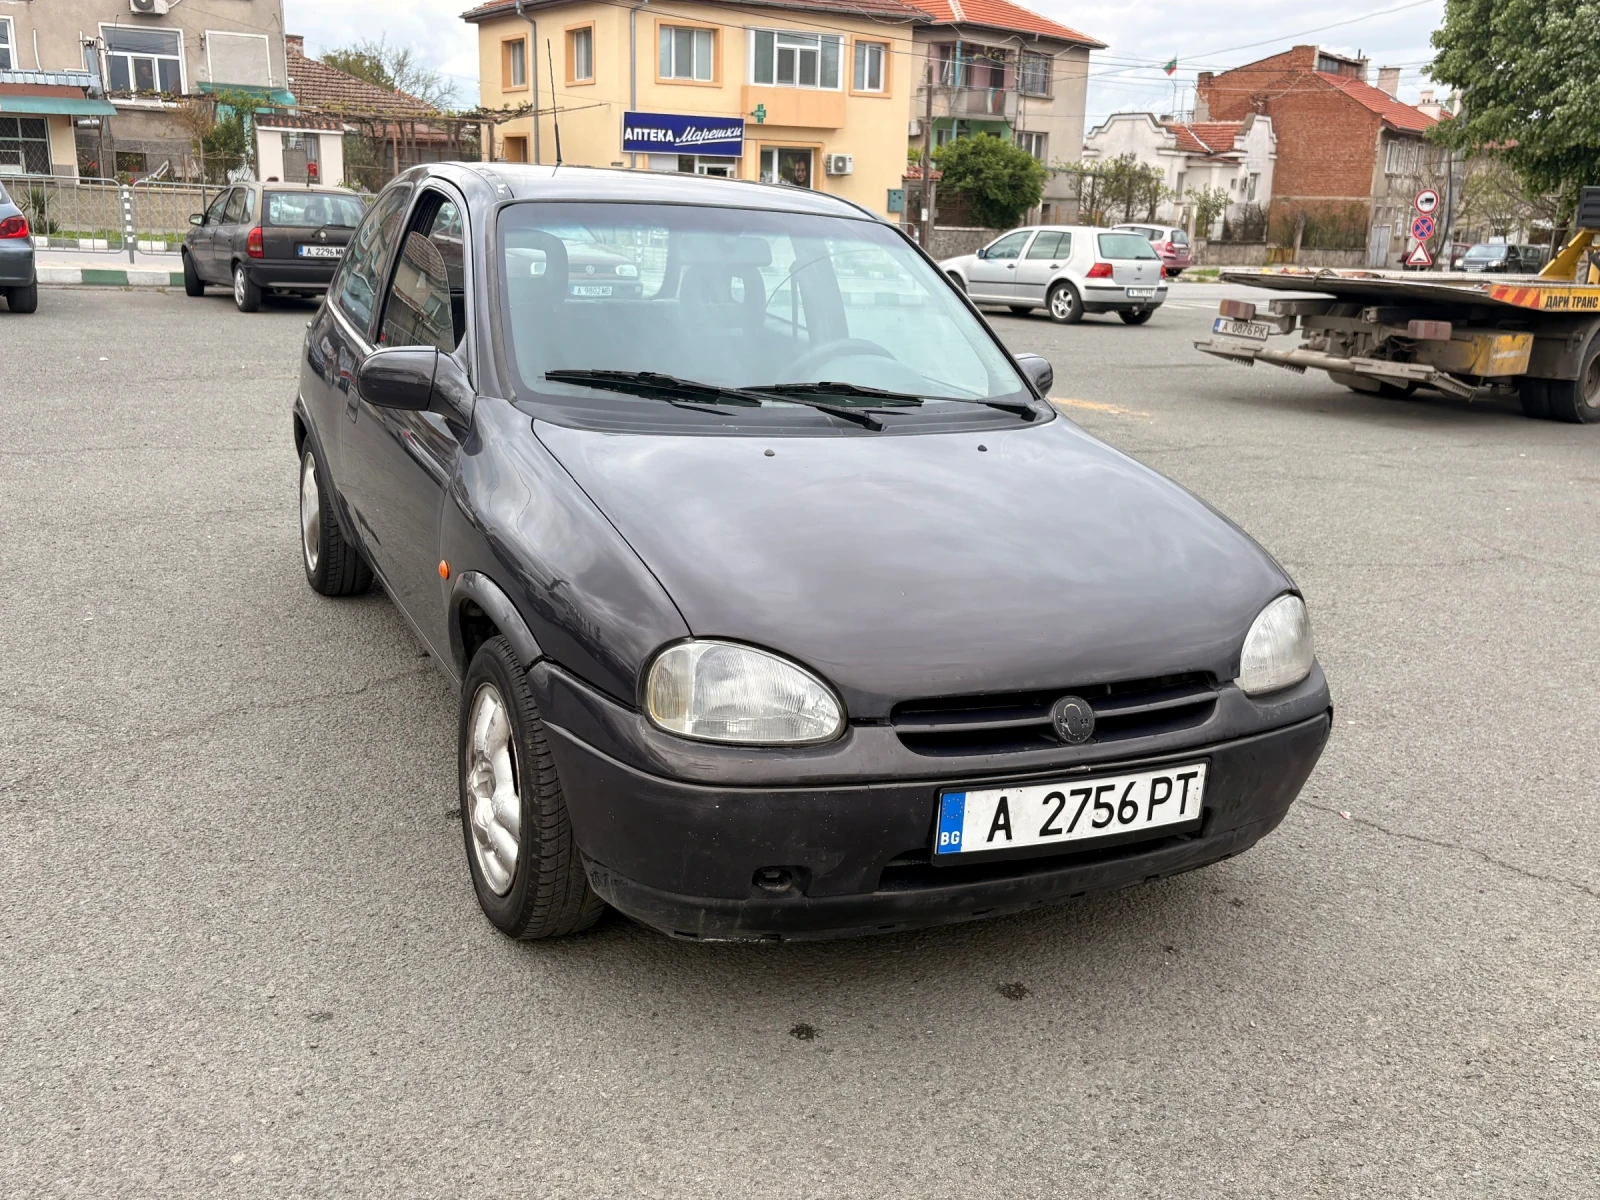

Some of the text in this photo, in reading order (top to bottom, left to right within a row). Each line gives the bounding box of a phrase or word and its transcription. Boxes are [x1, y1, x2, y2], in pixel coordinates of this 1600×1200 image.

[624, 126, 742, 144] АПТЕКА Марешки
[1545, 295, 1599, 309] ДАРИ ТРАНС
[986, 796, 1013, 843] A
[940, 831, 961, 846] BG
